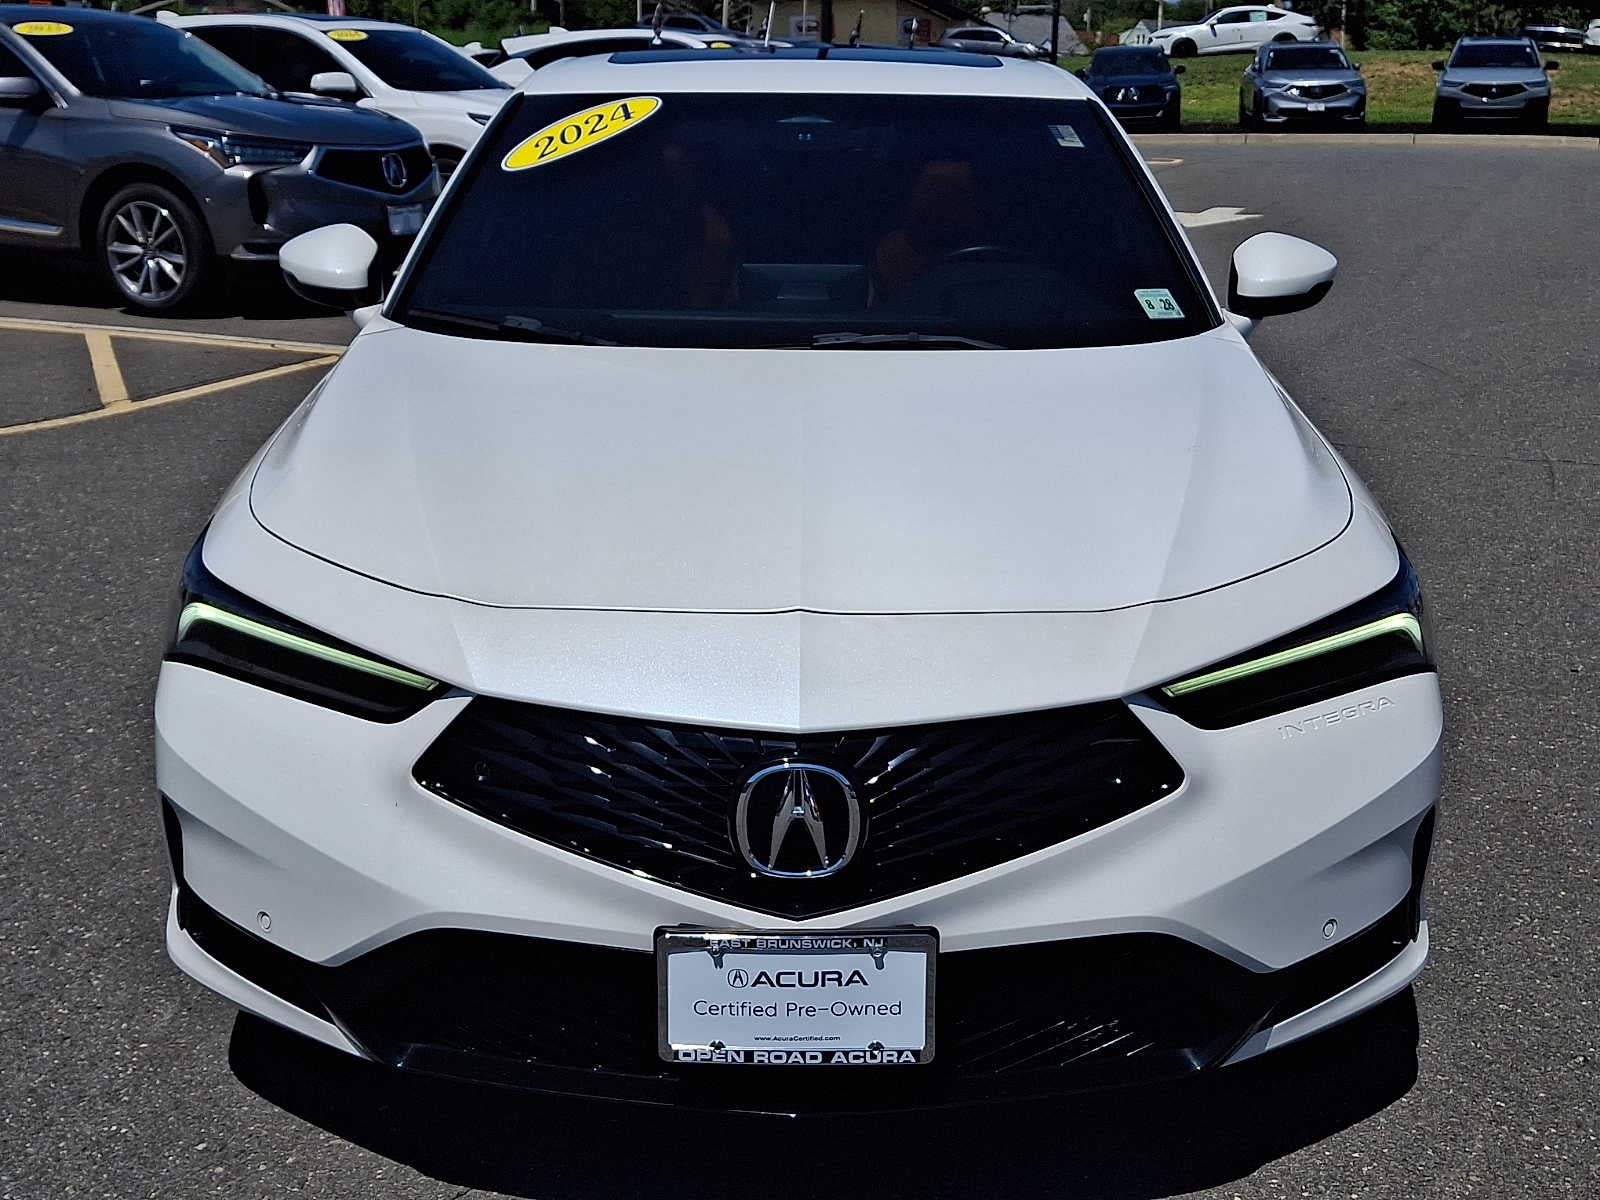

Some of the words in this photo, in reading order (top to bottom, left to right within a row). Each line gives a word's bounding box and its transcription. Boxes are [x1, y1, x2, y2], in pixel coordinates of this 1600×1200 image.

[534, 102, 635, 160] 2024
[1145, 299, 1155, 310] 8
[1159, 299, 1175, 310] 28
[1278, 696, 1395, 740] INTEGRA
[710, 938, 751, 948] EAST
[756, 938, 857, 949] BRUNSWICK,
[750, 969, 869, 988] ACURA
[693, 1000, 777, 1017] Certified
[786, 1001, 902, 1017] Pre-Owned
[678, 1050, 745, 1063] OPEN
[753, 1051, 823, 1064] ROAD
[830, 1050, 916, 1064] ACURA
